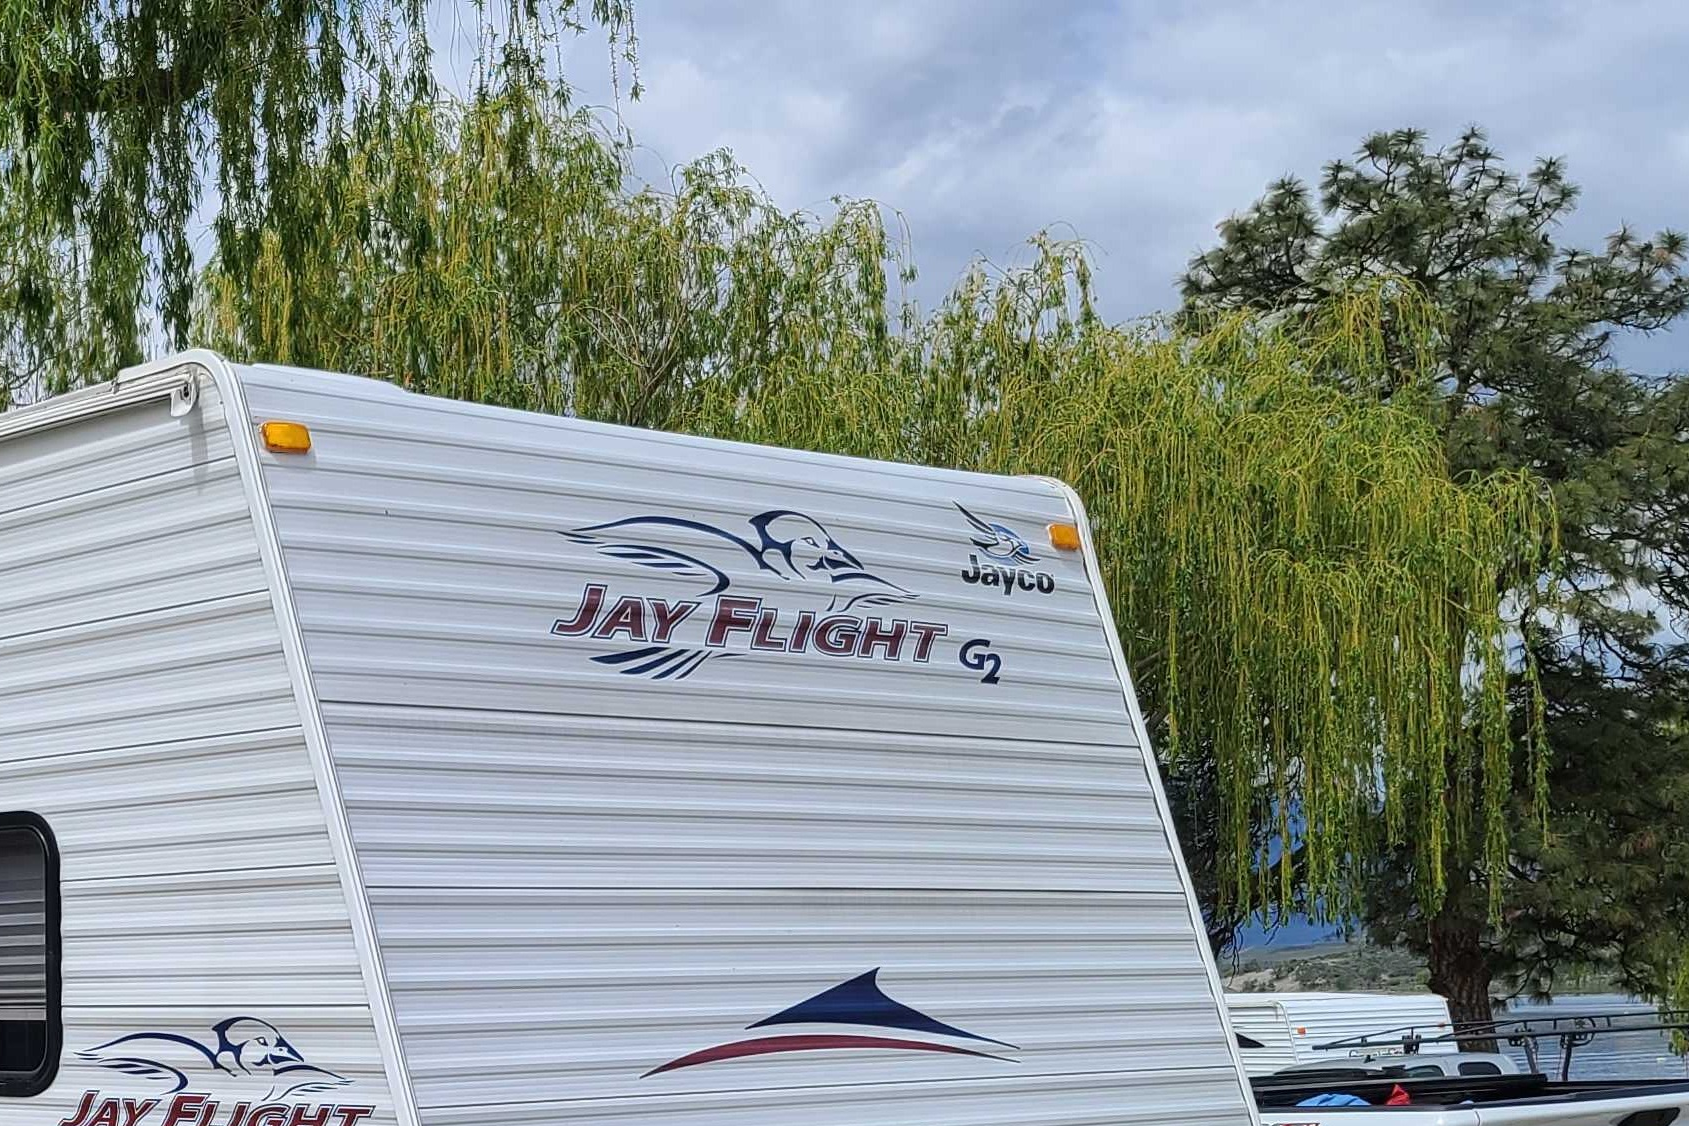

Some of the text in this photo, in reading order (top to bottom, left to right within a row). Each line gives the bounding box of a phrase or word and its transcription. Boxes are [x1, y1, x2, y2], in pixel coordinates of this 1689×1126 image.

[961, 555, 1055, 595] Jayco
[552, 583, 948, 661] JAY FLIGHT
[958, 638, 1001, 684] G2
